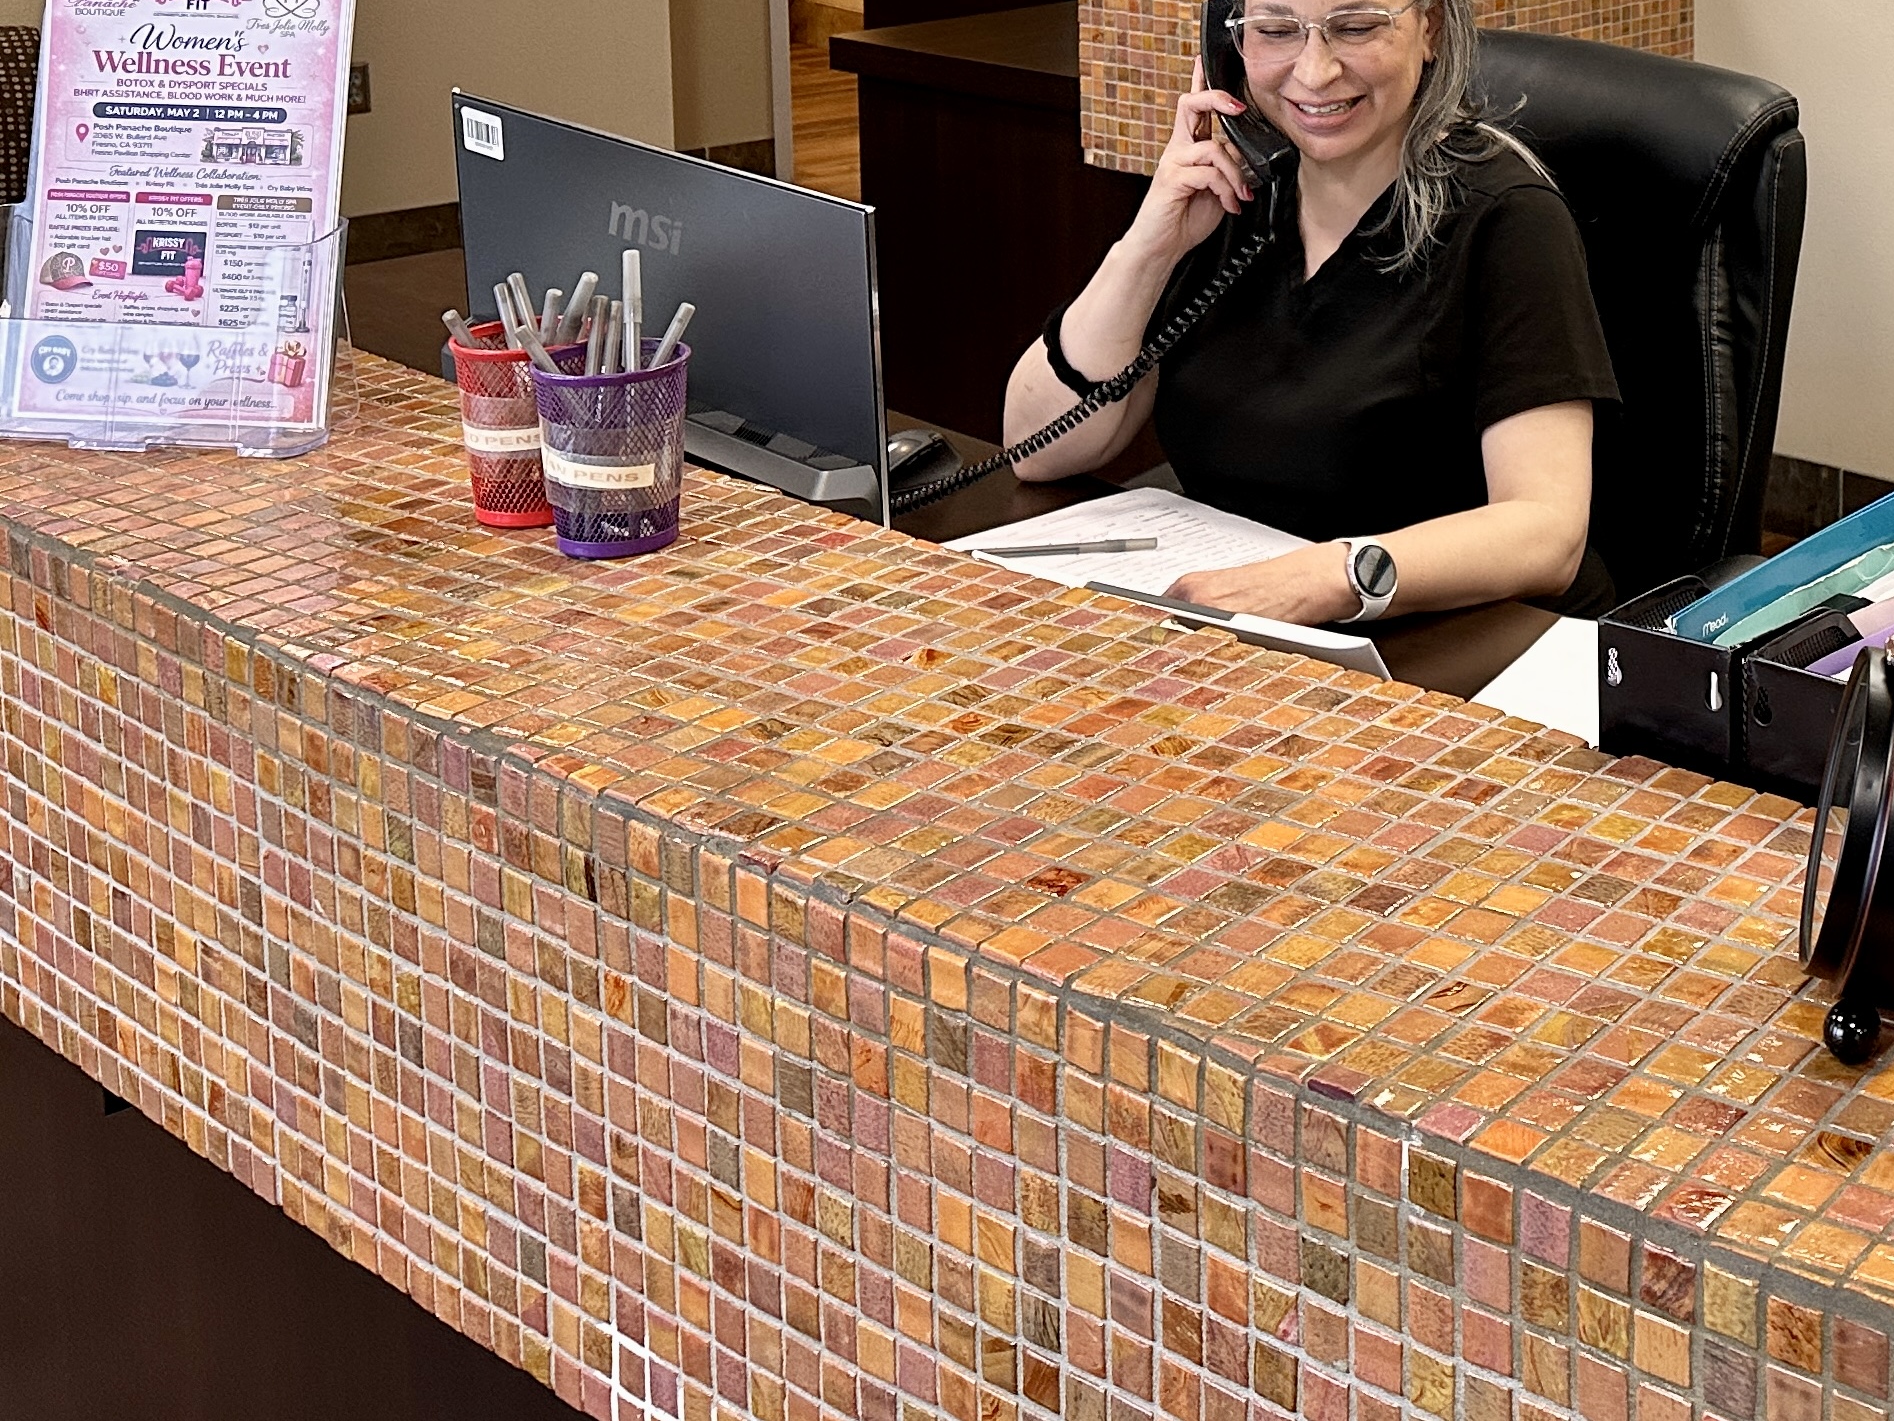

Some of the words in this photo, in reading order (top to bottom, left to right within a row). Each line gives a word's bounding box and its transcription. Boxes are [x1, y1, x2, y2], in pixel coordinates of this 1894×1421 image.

[75, 8, 126, 16] BOUTIQUE
[269, 19, 296, 34] Jolie
[298, 20, 331, 36] Molly
[92, 50, 211, 76] Wellness
[217, 54, 291, 78] Event
[116, 79, 155, 87] BOTOX
[158, 80, 166, 88] &
[169, 80, 217, 90] DYSPORT
[219, 82, 268, 91] SPECIALS
[102, 90, 165, 100] ASSISTANCE,
[168, 92, 202, 100] BLOOD
[204, 92, 234, 101] WORK
[105, 106, 165, 118] SATURDAY,
[167, 108, 191, 116] MAY
[192, 109, 200, 118] 2
[214, 109, 224, 118] 12
[227, 110, 244, 118] PM
[252, 111, 260, 119] 4
[262, 111, 278, 120] PM
[116, 124, 152, 132] Panache
[154, 125, 192, 134] Boutique
[109, 165, 150, 177] Featured
[153, 167, 193, 178] Wellness
[66, 204, 88, 213] 10%
[90, 205, 111, 213] OFF
[152, 207, 174, 216] 10%
[176, 208, 197, 217] OFF
[608, 200, 683, 255] msi
[153, 238, 185, 248] KRISSY
[161, 251, 176, 260] FIT
[99, 262, 118, 271] $50
[92, 290, 112, 300] Event
[258, 343, 268, 356] &
[56, 389, 84, 401] Come
[136, 393, 158, 404] and
[158, 393, 186, 406] focus
[204, 398, 228, 409] your
[574, 469, 639, 483] PENS
